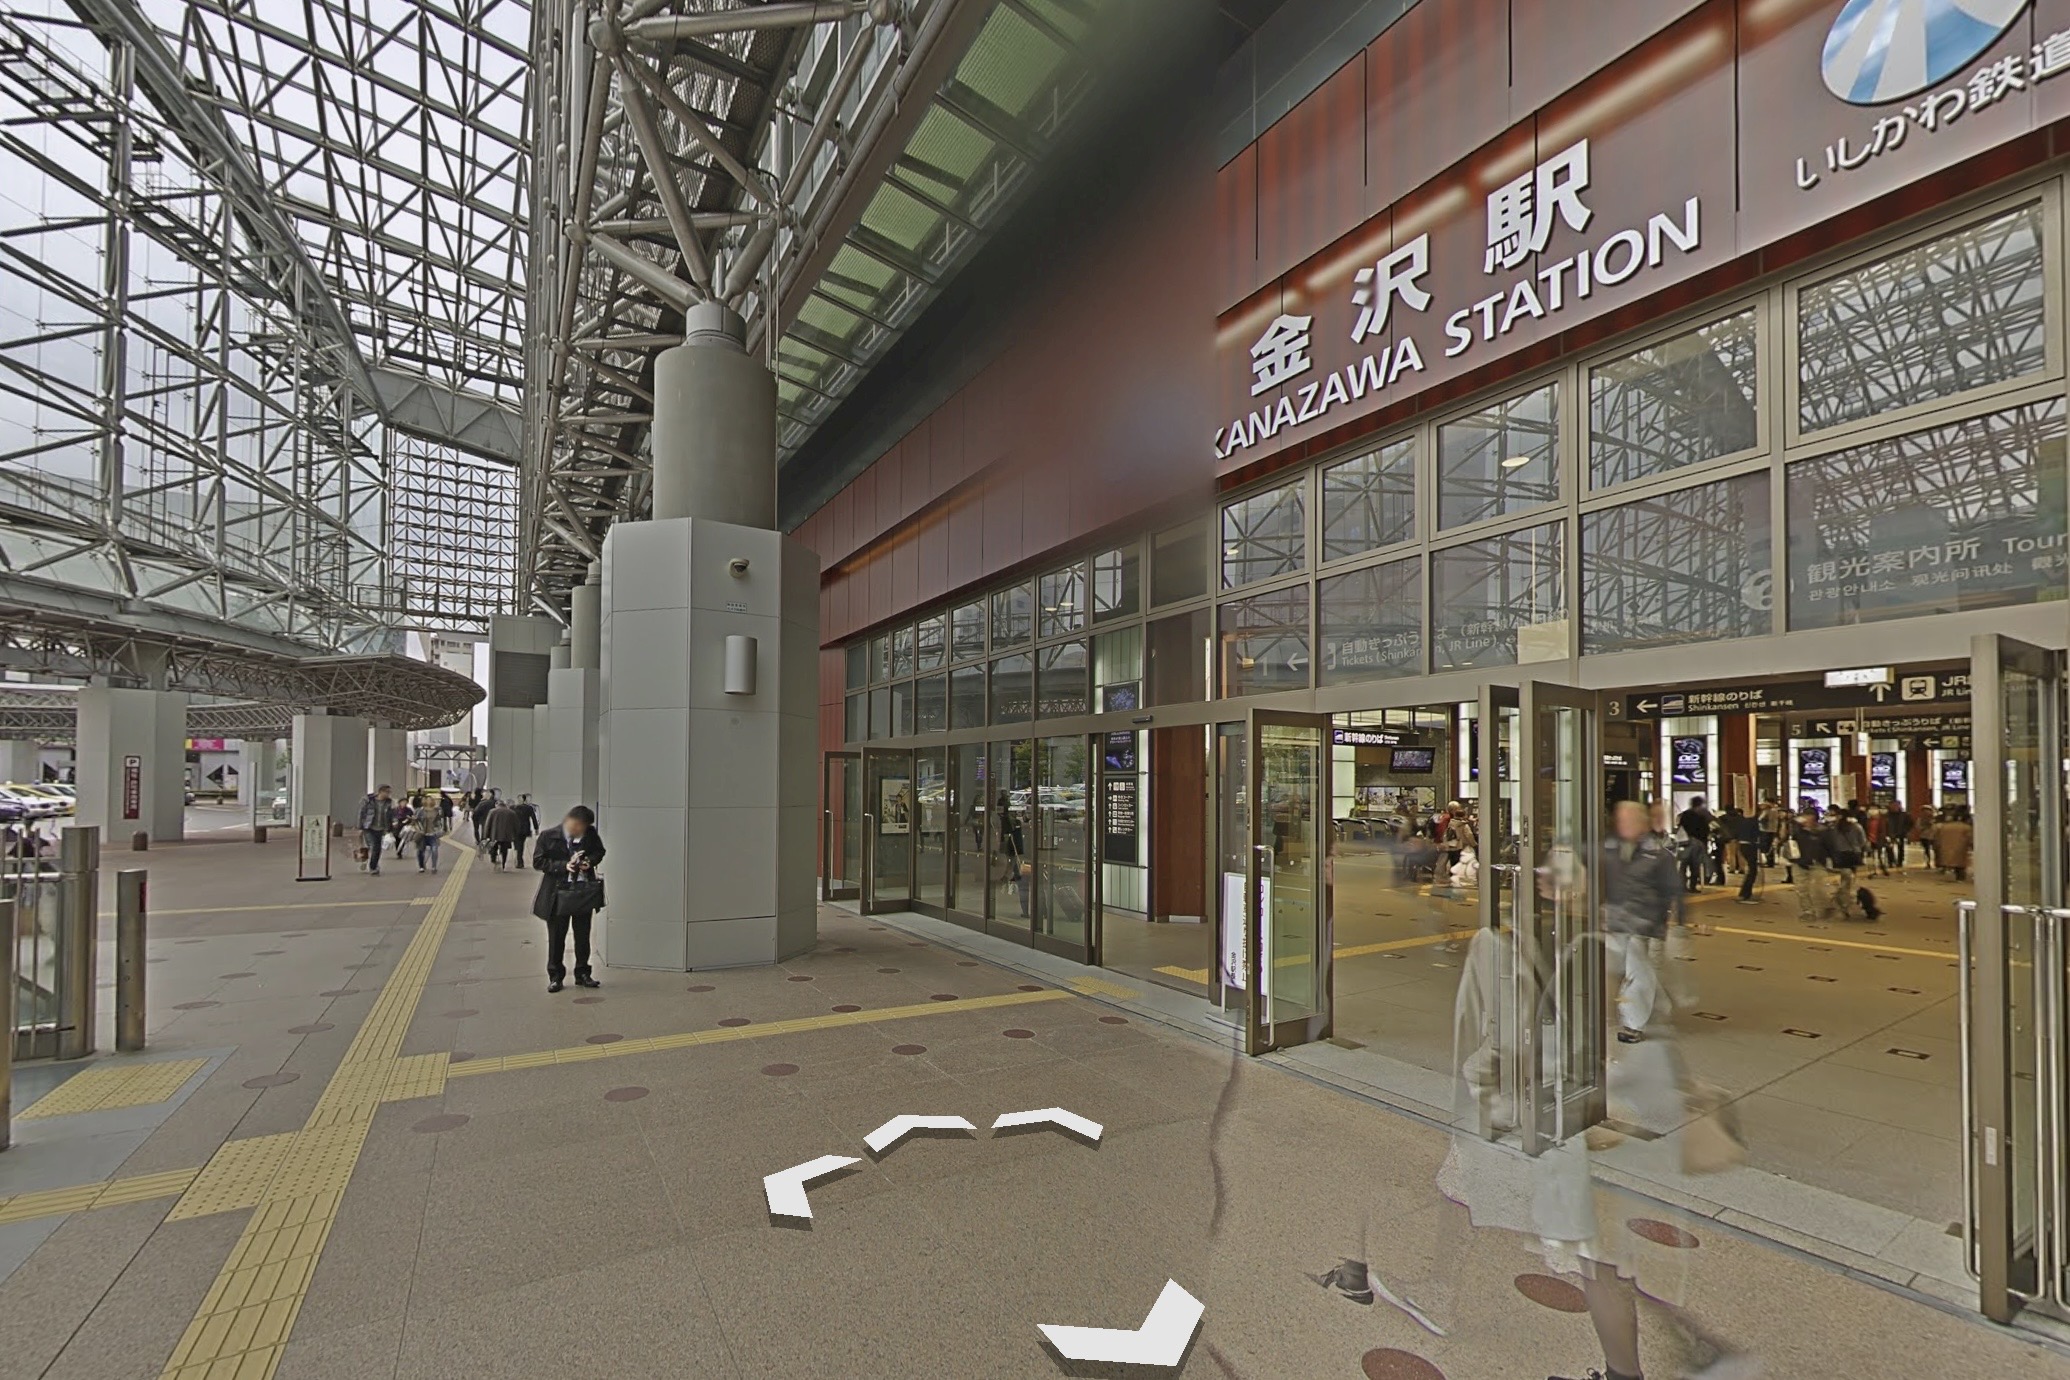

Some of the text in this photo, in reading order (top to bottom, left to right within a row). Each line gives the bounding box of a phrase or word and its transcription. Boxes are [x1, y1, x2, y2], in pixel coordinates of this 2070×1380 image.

[1250, 138, 1593, 397] 金沢駅
[1444, 196, 1700, 358] STATION
[1807, 536, 1981, 585] 観光案内所
[1342, 656, 1373, 667] Tickets
[1688, 690, 1763, 704] 新幹線のりば
[1609, 701, 1620, 716] 3
[1688, 703, 1739, 712] Shinkansen
[1791, 725, 1801, 735] 5
